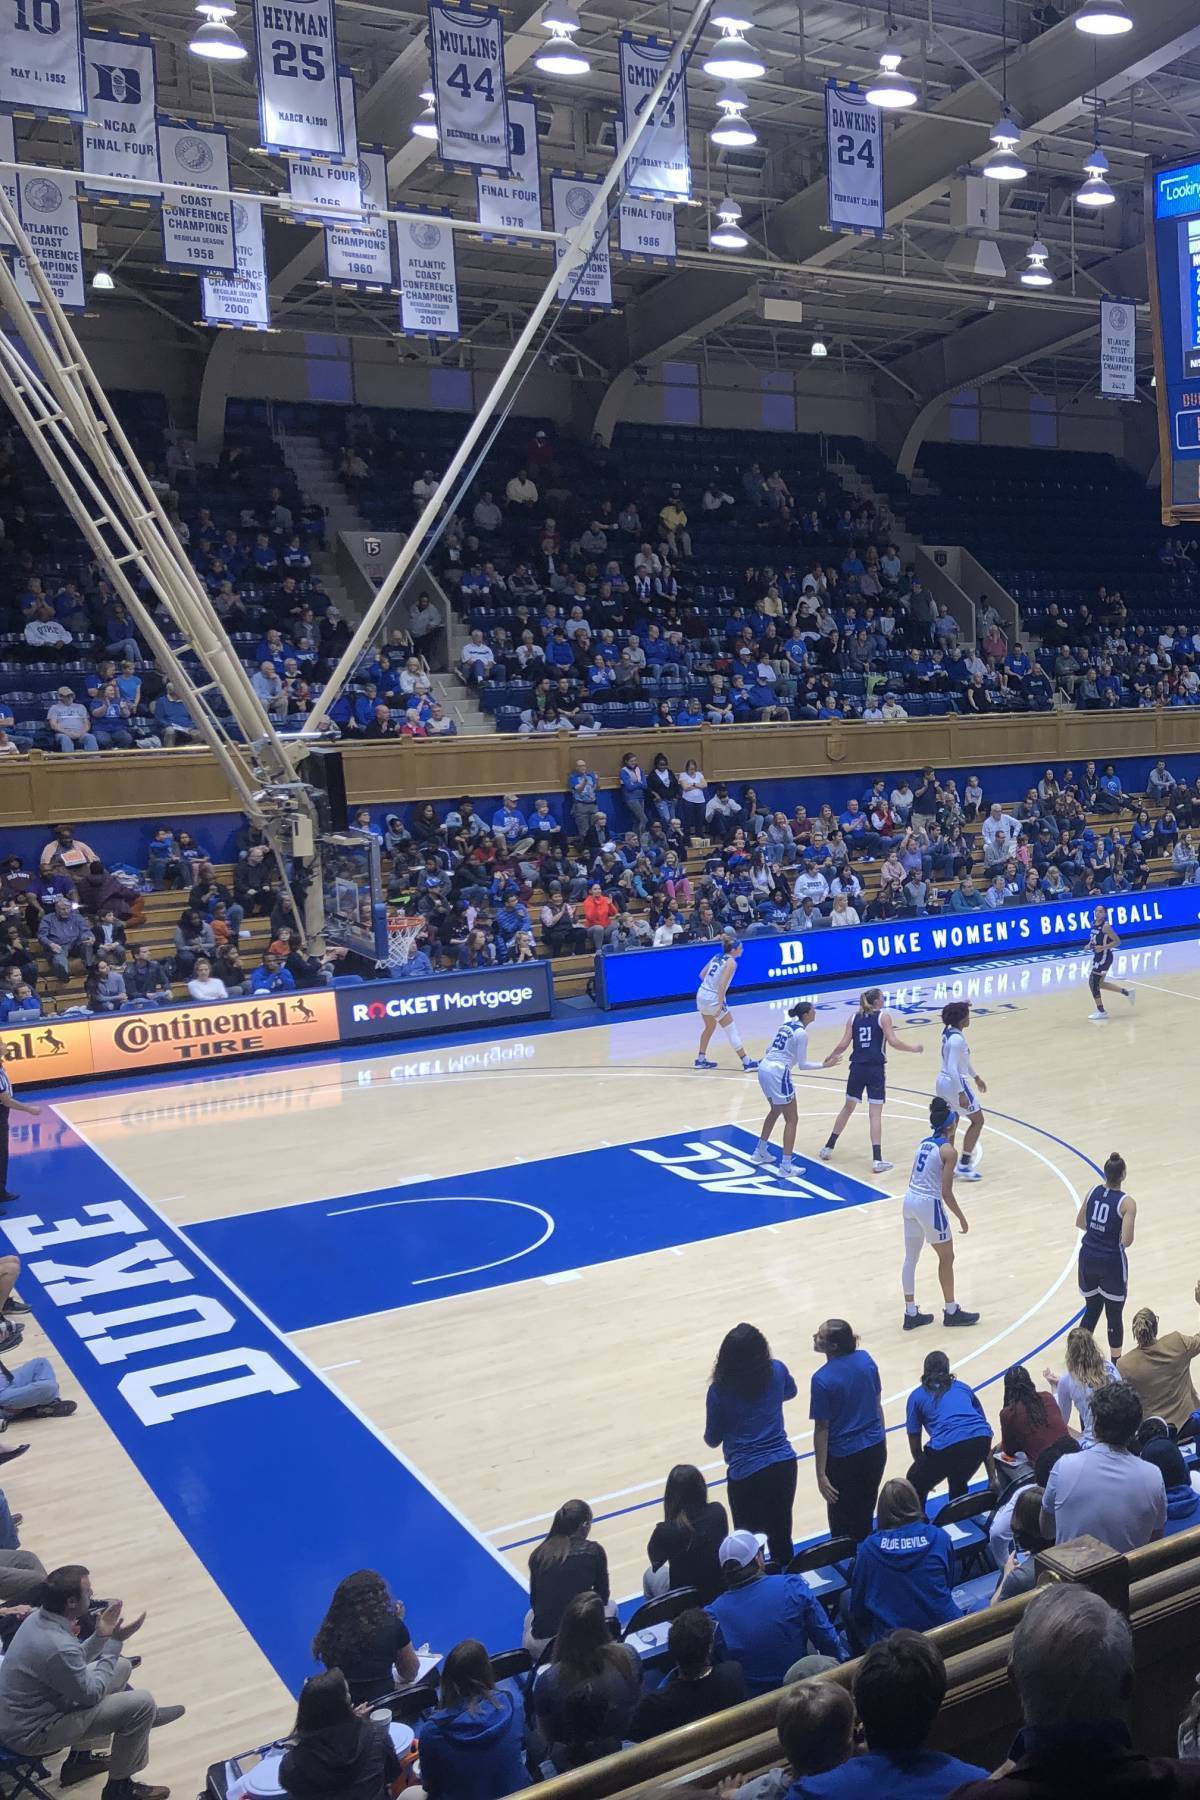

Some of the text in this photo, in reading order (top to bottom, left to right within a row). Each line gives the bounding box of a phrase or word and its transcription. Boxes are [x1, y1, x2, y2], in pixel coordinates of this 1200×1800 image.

[14, 0, 61, 34] 10
[262, 5, 328, 38] HEYMAN
[439, 29, 498, 61] MULLINS
[271, 40, 325, 81] 25
[10, 67, 31, 79] MAY
[34, 70, 42, 82] 1,
[446, 63, 495, 103] 44
[278, 111, 304, 123] MARCH
[832, 108, 876, 134] DAWKINS
[103, 119, 137, 134] NCAA
[86, 137, 154, 156] FINAL FOUR
[837, 134, 875, 169] 24
[292, 163, 357, 183] FINAL FOUR
[481, 184, 537, 202] FINAL FOUR
[180, 194, 212, 208] COAST
[165, 208, 230, 222] CONFERENCE
[500, 215, 524, 228] 1978
[622, 205, 673, 223] FINAL FOUR
[23, 222, 69, 236] ATLANTIC
[168, 218, 228, 235] CHAMPIONS
[31, 237, 62, 248] COAST
[331, 235, 386, 250] CHAMPIONS
[637, 235, 660, 247] 1986
[187, 248, 214, 260] 1958
[348, 262, 373, 275] 1960
[408, 258, 446, 270] ATLANTIC
[415, 270, 441, 281] COAST
[403, 279, 455, 293] CONFERENCE
[405, 290, 453, 303] CHAMPIONS
[224, 303, 250, 315] 2000
[419, 315, 442, 325] 2001
[366, 542, 380, 554] 15
[861, 931, 921, 959] DUKE
[932, 917, 1031, 950] WOMEN'S
[708, 964, 718, 977] 2
[352, 987, 532, 1022] ROCKET Mortgage
[114, 1002, 290, 1053] Continental
[858, 1026, 872, 1042] 21
[173, 1035, 265, 1059] TIRE
[916, 1153, 928, 1173] 5
[1091, 1200, 1110, 1224] 10
[0, 1200, 301, 1427] DUKE
[880, 1536, 930, 1550] BLUE DEVILS
